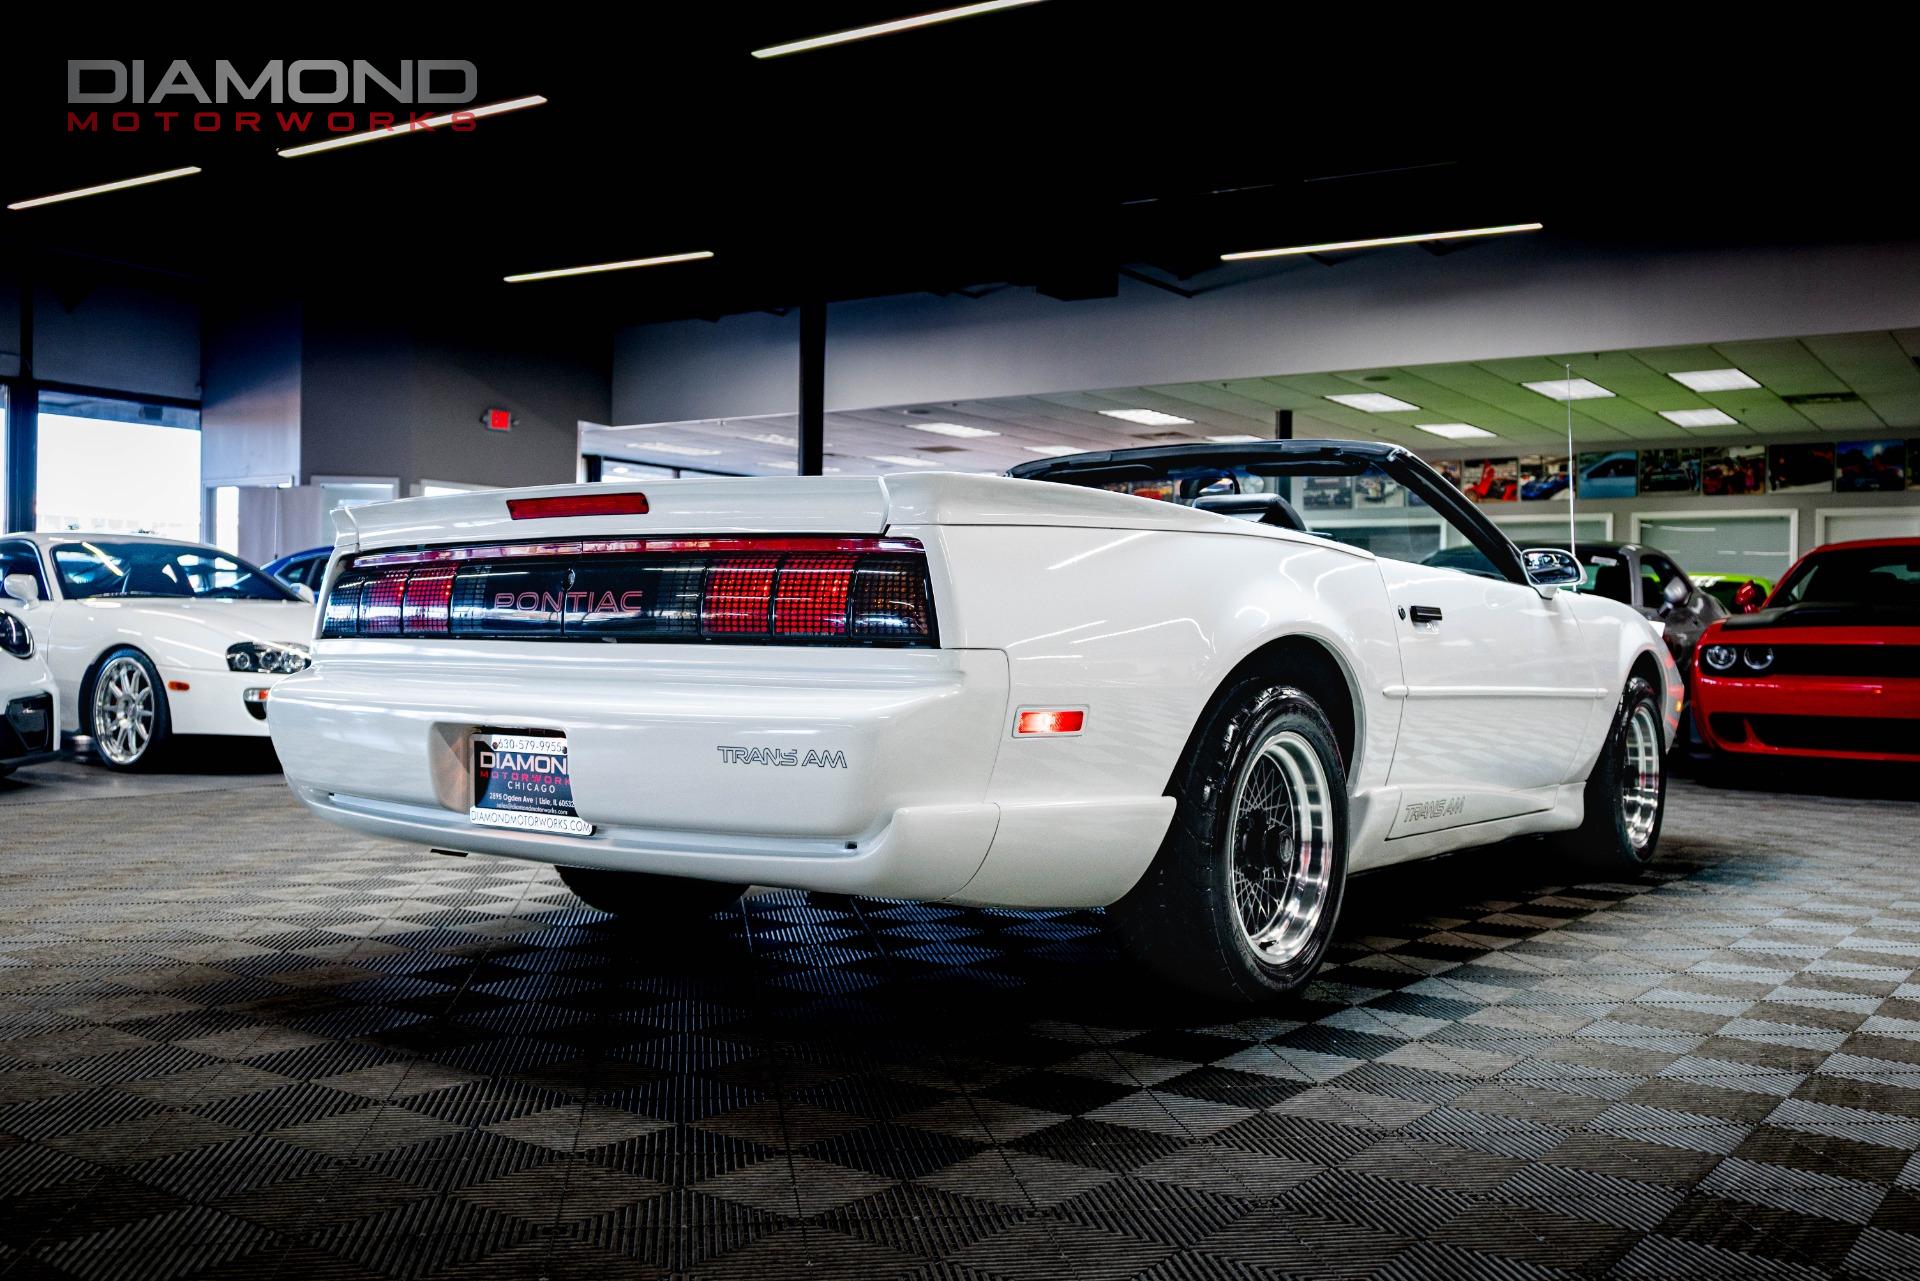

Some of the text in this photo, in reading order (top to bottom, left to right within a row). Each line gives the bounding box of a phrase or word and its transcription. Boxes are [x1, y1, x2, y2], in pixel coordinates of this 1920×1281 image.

[494, 590, 643, 613] PONTIAC
[498, 738, 562, 753] 630-579-9955
[717, 745, 848, 769] TRANS AM
[480, 751, 567, 775] DIAMON
[480, 770, 571, 785] MOTORWORK
[507, 782, 556, 794] CHICAGO
[503, 794, 522, 803] Ogden
[522, 795, 534, 804] Ave
[1404, 799, 1447, 822] TRANS
[471, 810, 592, 833] DIAMONDMOTORWORKS.COM
